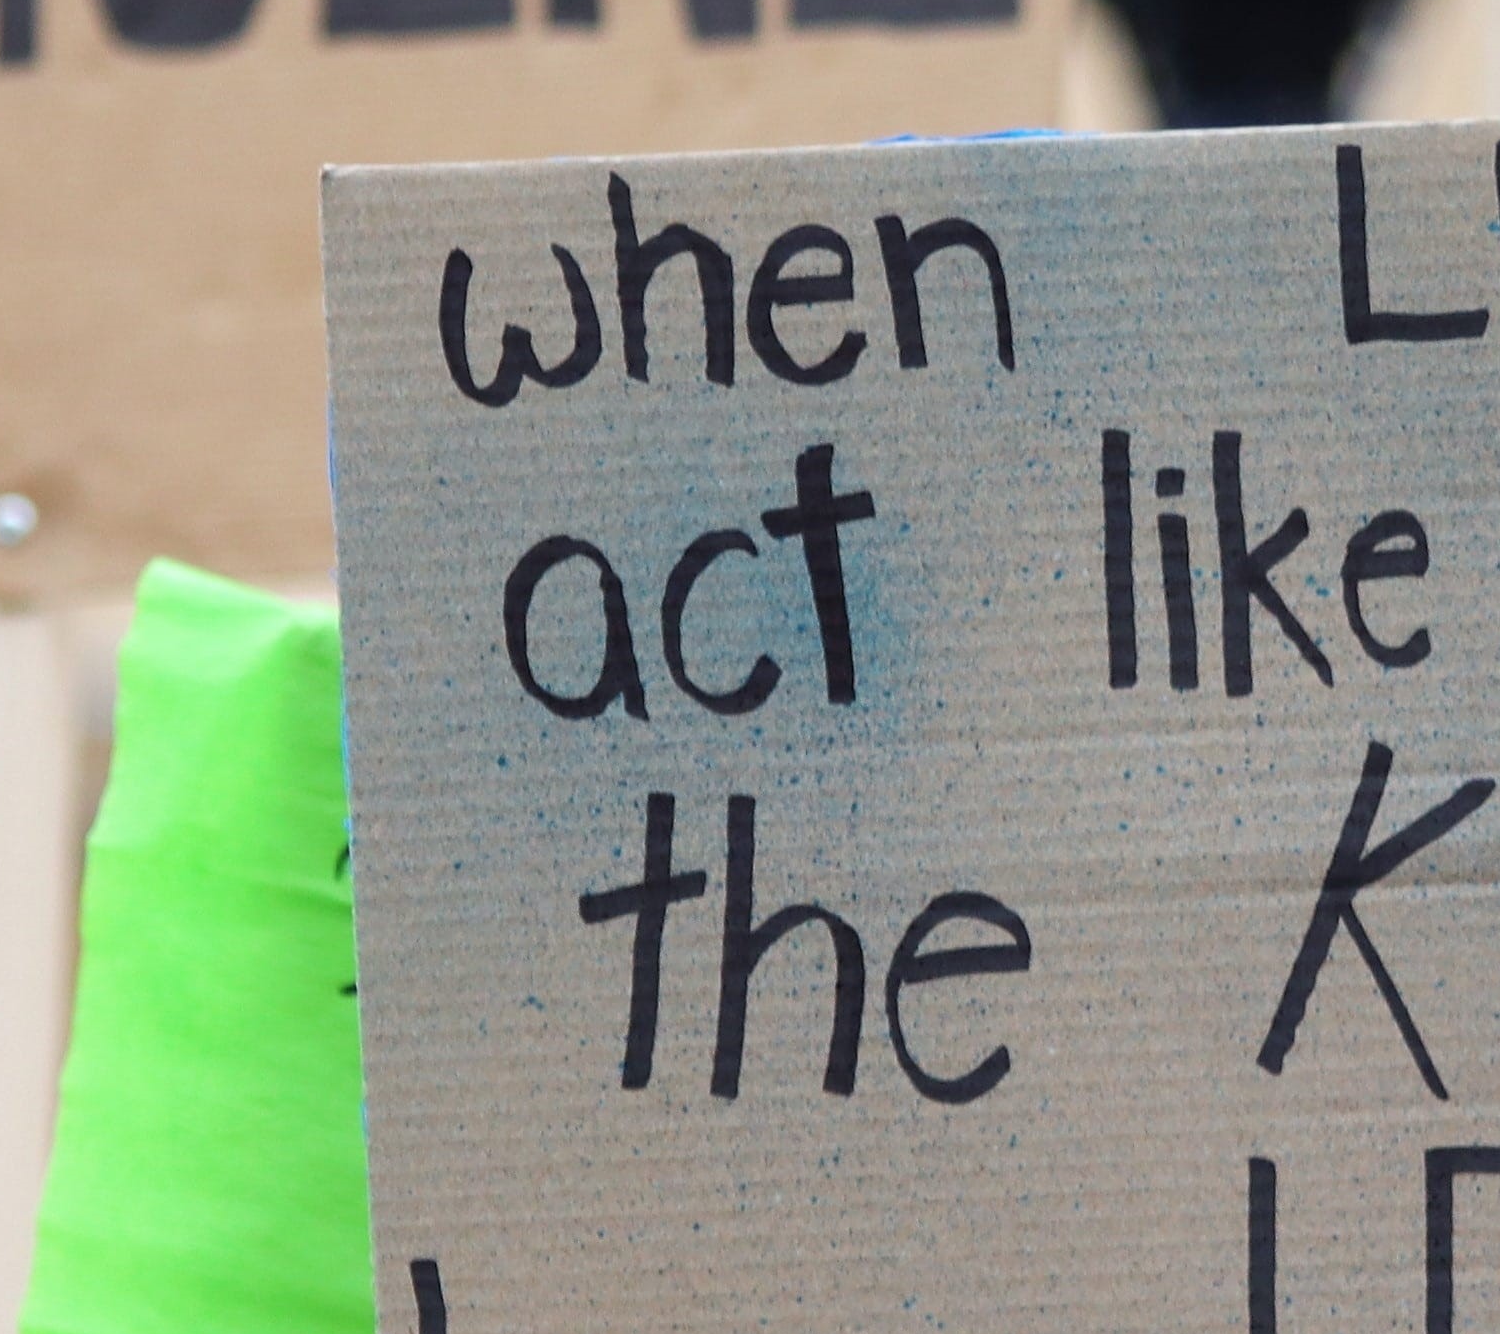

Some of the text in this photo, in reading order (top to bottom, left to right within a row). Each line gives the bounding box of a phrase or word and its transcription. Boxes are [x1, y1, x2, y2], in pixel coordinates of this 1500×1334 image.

[438, 171, 1016, 408] when
[502, 443, 877, 721] act
[1101, 428, 1431, 698] like
[578, 792, 1032, 1103] the
